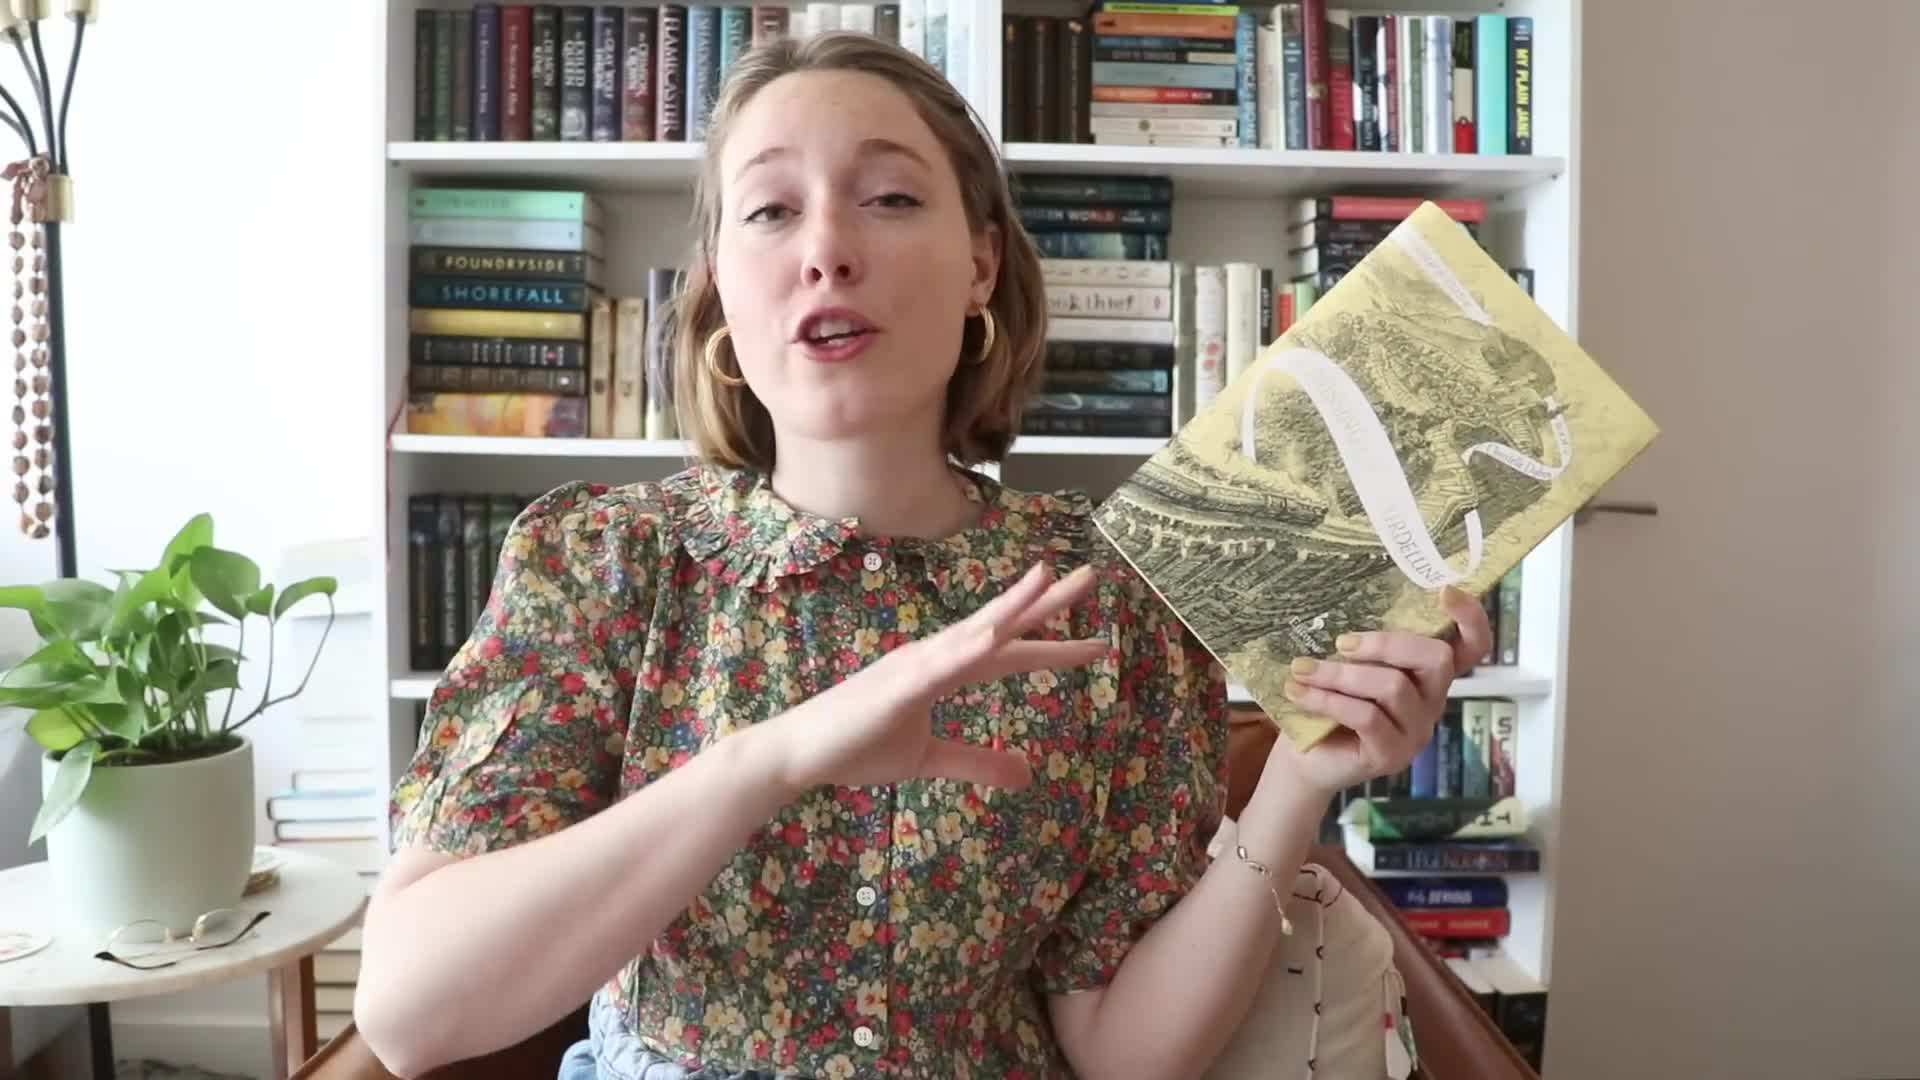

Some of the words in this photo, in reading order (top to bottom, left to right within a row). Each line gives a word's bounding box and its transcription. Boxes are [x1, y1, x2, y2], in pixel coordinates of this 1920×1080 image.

[1515, 48, 1529, 67] MY
[1515, 69, 1529, 105] PLAIN
[1516, 107, 1529, 139] JANE
[445, 255, 566, 273] FOUNDRYSIDE
[441, 284, 565, 304] SHOREFALL
